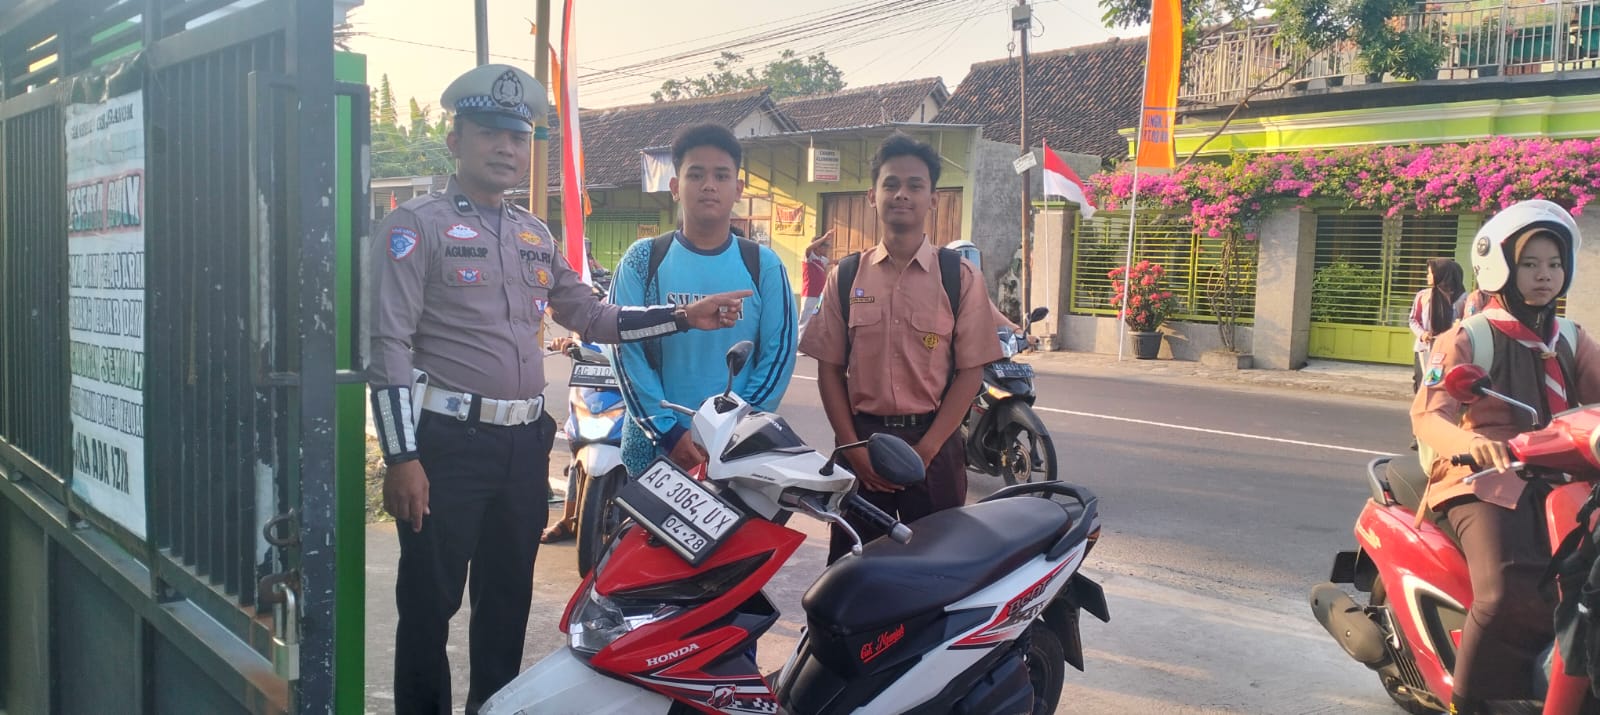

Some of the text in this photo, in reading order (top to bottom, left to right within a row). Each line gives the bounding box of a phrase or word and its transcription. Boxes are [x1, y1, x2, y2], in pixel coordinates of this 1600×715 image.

[519, 248, 551, 264] POLRI
[577, 366, 589, 376] AG
[92, 437, 109, 485] ADA
[646, 468, 732, 534] AG 3064 UX
[646, 643, 700, 667] HONDA
